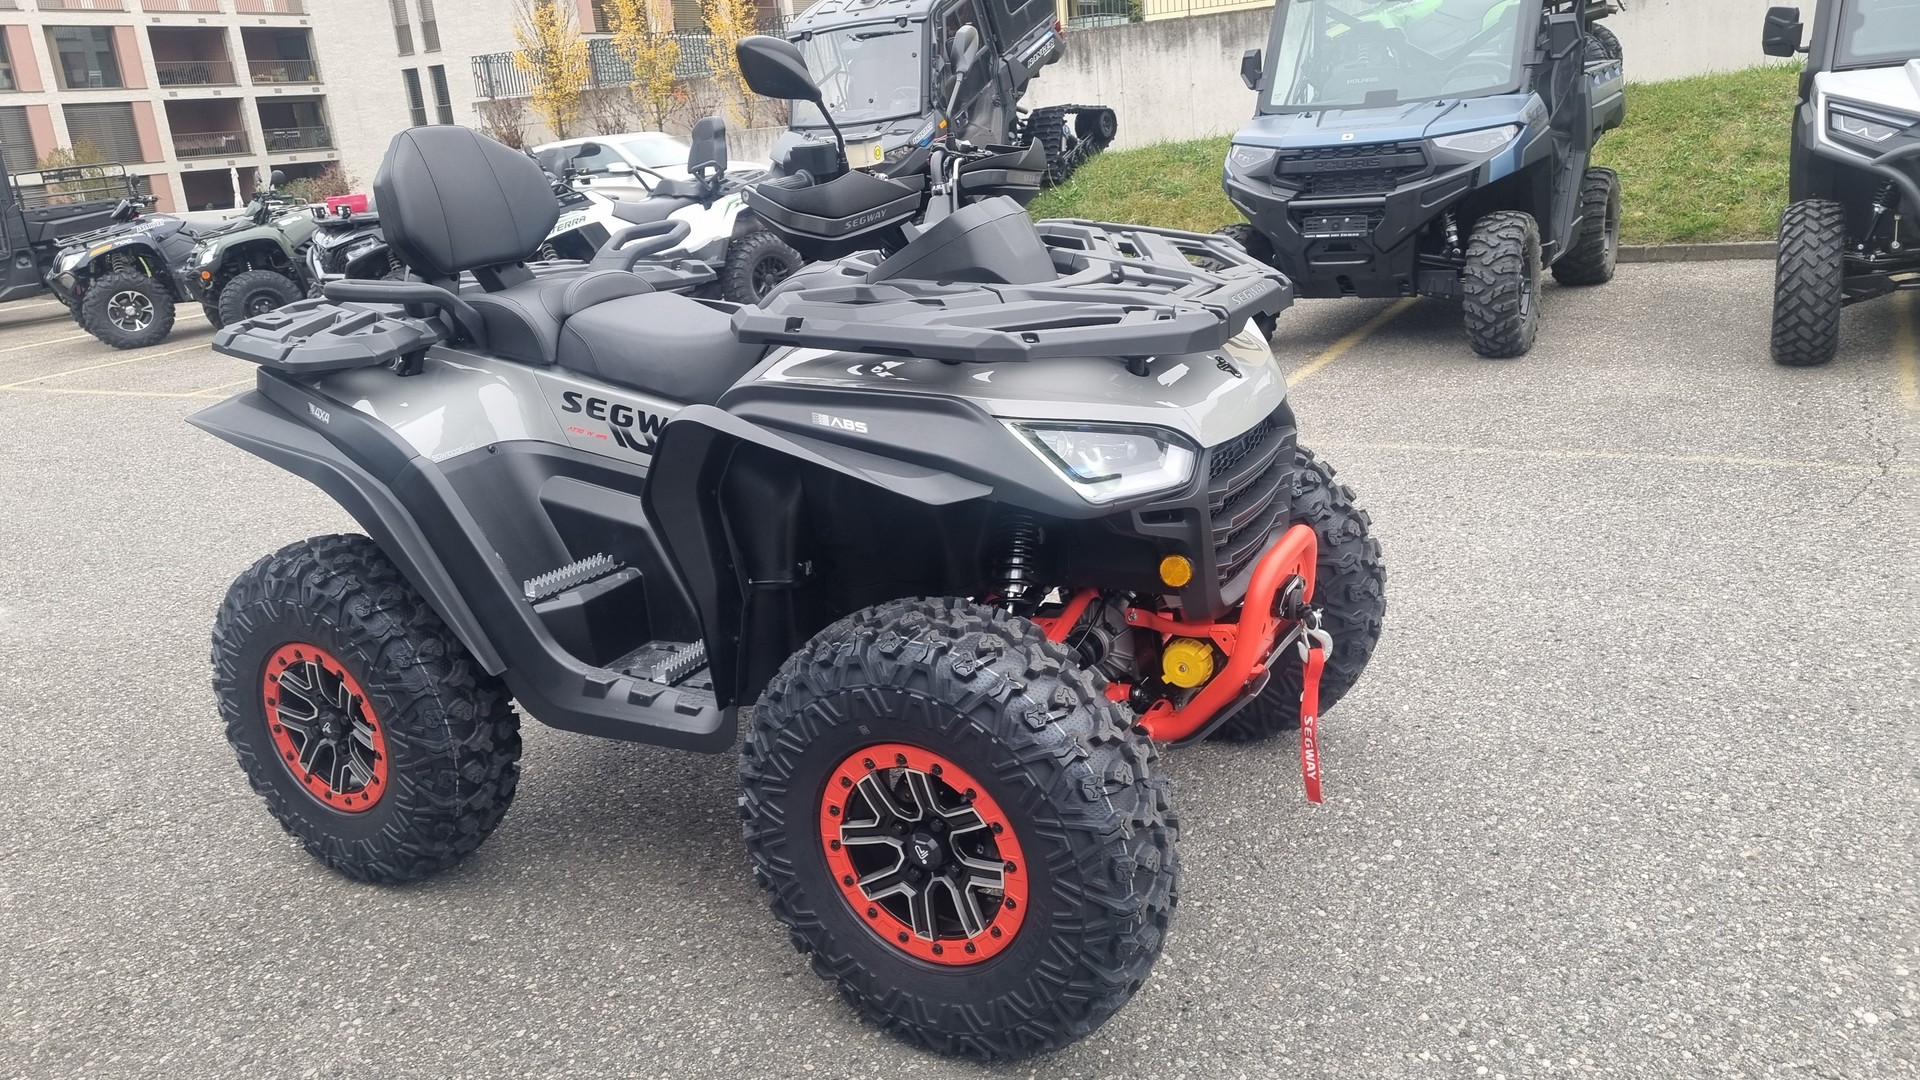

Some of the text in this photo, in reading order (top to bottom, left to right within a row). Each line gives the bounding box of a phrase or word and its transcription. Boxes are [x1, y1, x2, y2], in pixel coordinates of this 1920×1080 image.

[1315, 158, 1381, 171] POLARIS
[844, 208, 887, 231] SEGWAY
[1231, 281, 1268, 306] SEGWAY
[830, 416, 868, 434] ABS
[1304, 715, 1317, 781] SEGWAY
